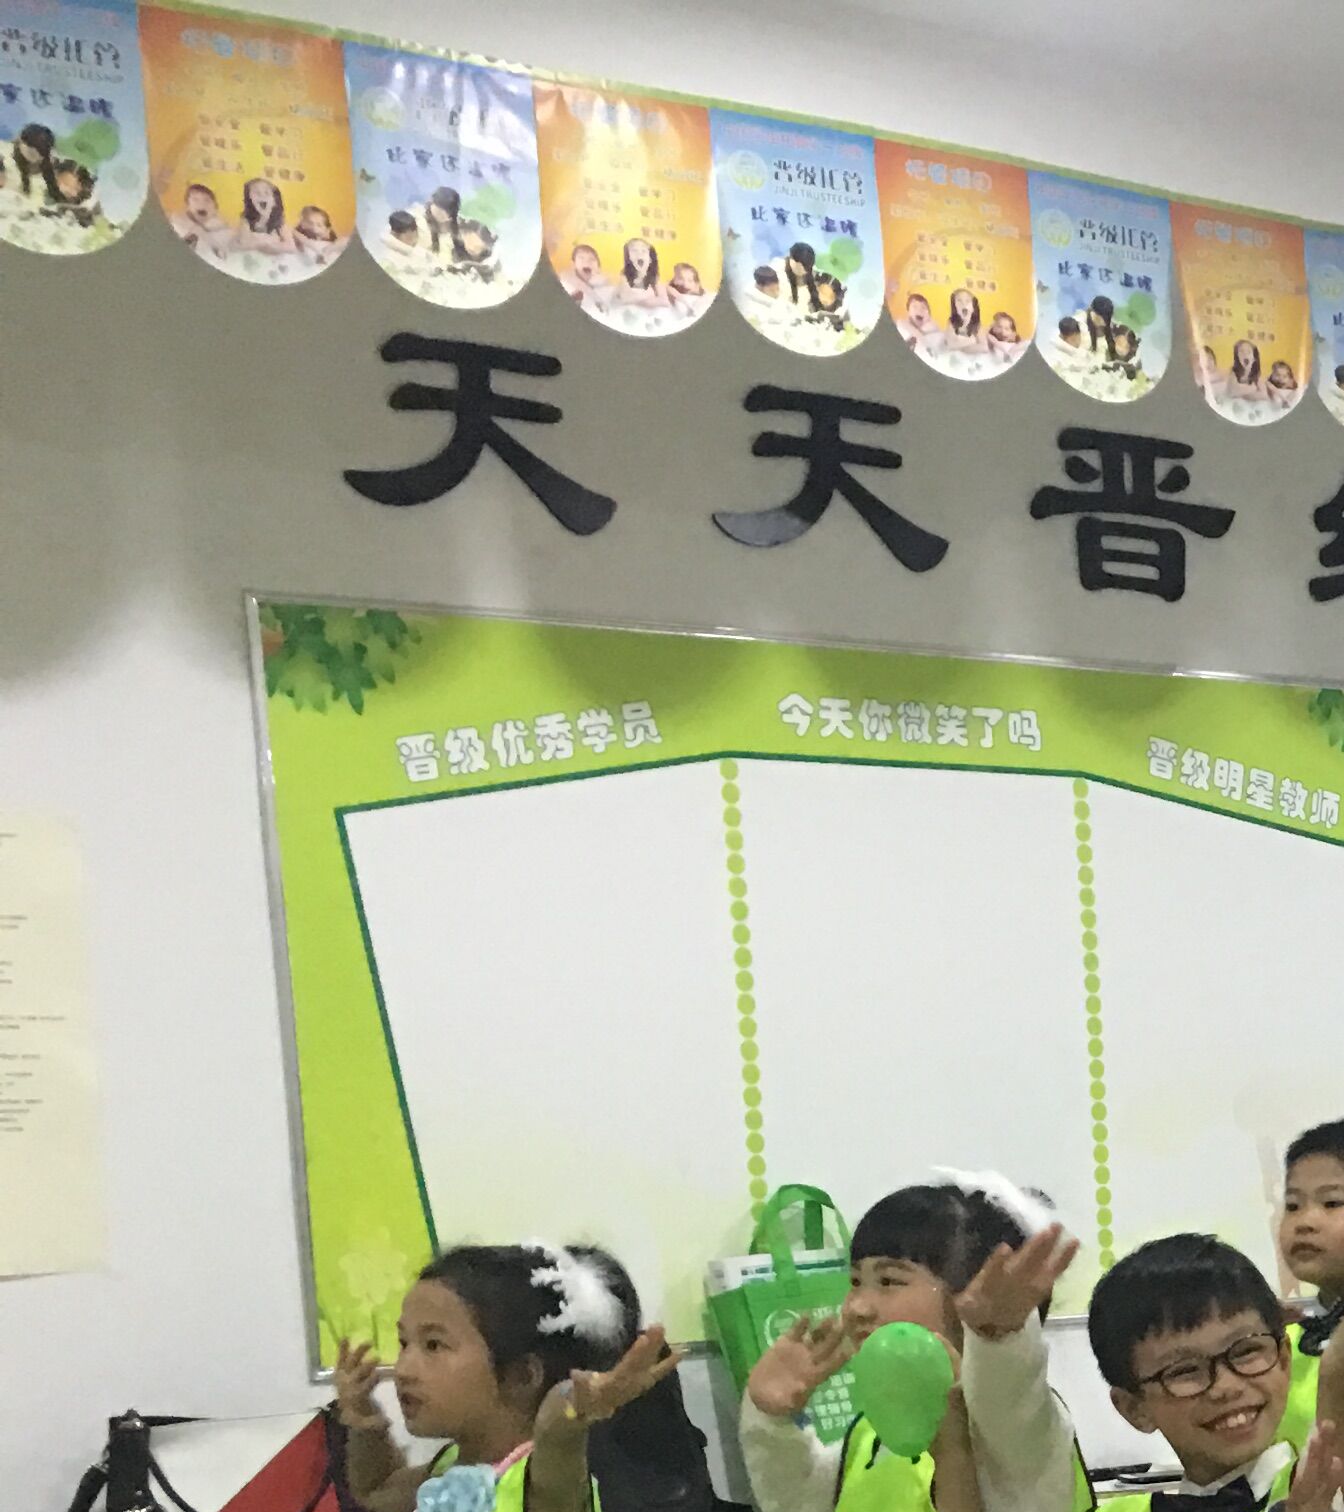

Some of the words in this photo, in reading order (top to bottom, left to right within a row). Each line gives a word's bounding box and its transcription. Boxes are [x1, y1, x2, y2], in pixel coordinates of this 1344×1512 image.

[395, 700, 662, 783] 晋级优秀学员
[777, 692, 1043, 752] 今天你微笑了吗
[1147, 735, 1341, 829] 晋级明星教师
